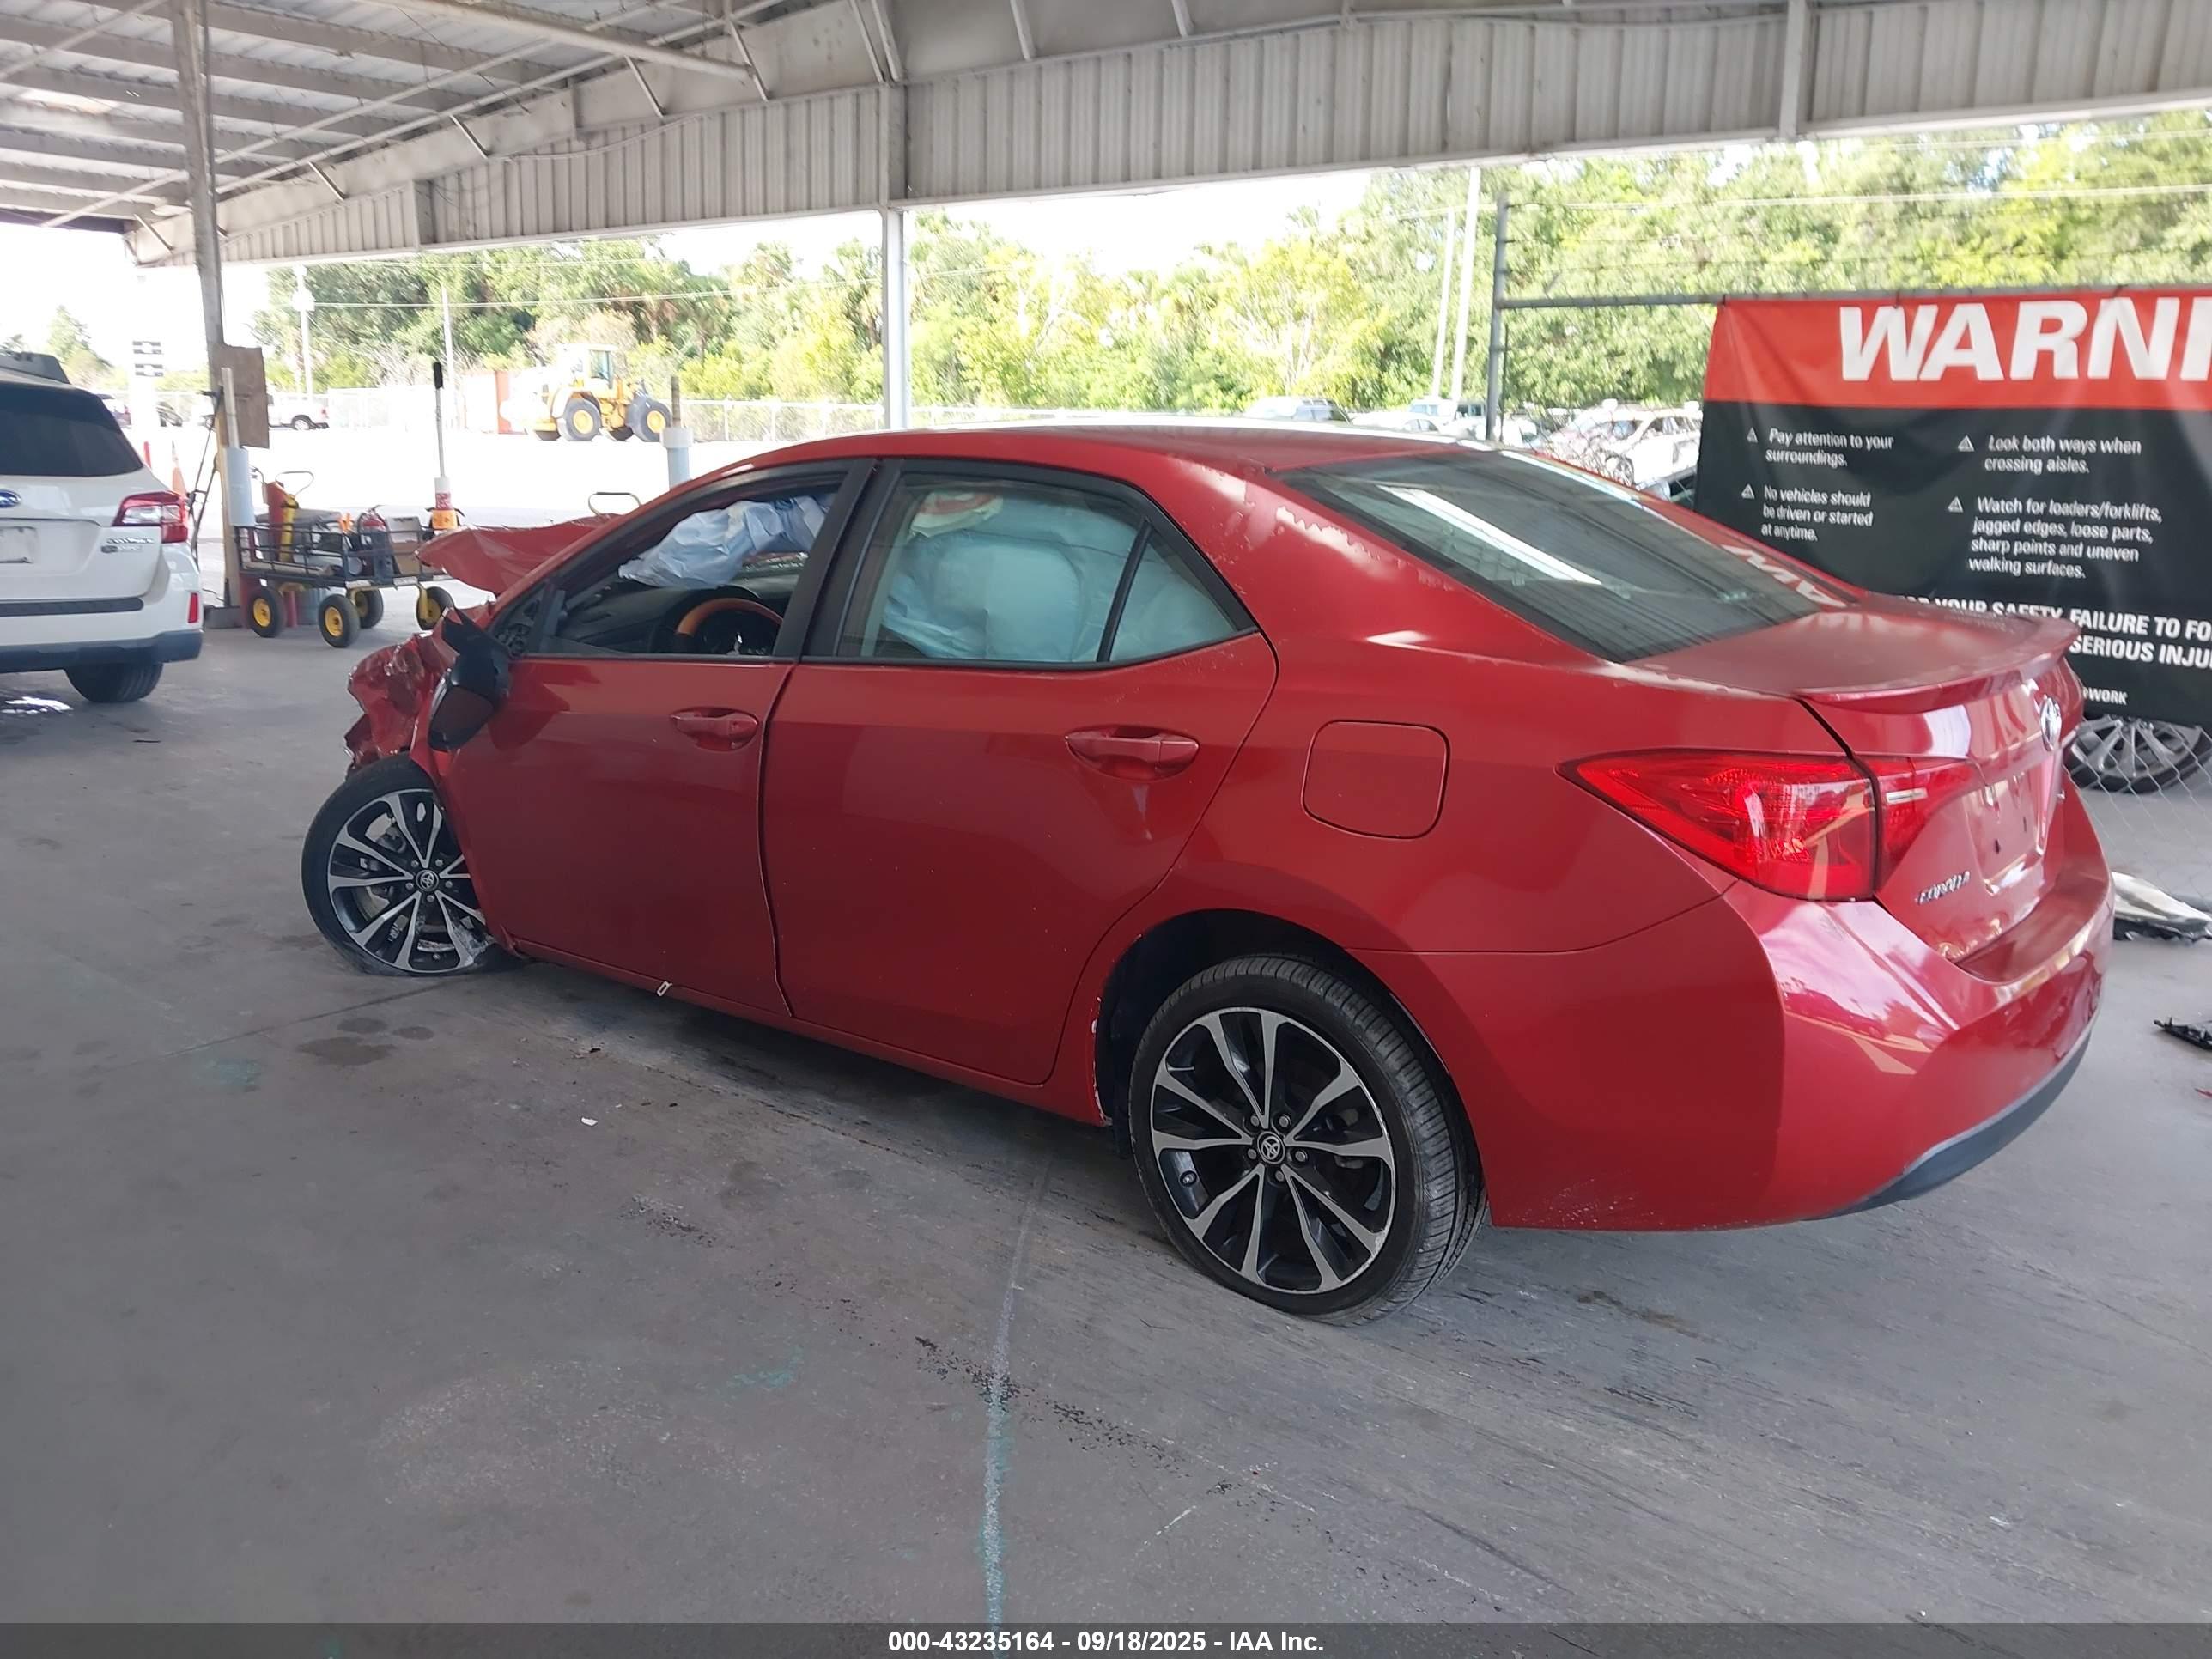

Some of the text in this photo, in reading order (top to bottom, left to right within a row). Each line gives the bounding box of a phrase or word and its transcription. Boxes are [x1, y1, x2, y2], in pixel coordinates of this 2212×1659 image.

[1769, 428, 1894, 452] Pay attention to your
[1988, 434, 2142, 455] Look both ways when
[1765, 449, 1847, 469] surroundings.
[1984, 455, 2090, 475] crossing aisles.
[1765, 485, 1871, 507] No vehicles should
[1763, 503, 1874, 526] be driven or started
[1978, 496, 2163, 524] Watch for loaders/forklifts,
[1761, 523, 1818, 541] at anytime.
[1972, 517, 2154, 544] jagged edges, loose parts,
[1971, 537, 2139, 562] sharp points and uneven
[1969, 556, 2086, 579] walking surfaces.
[2069, 608, 2149, 635] FAILURE
[2154, 616, 2181, 638] TO
[2185, 619, 2212, 642] FO
[2069, 635, 2212, 671] SERIOUS INJU
